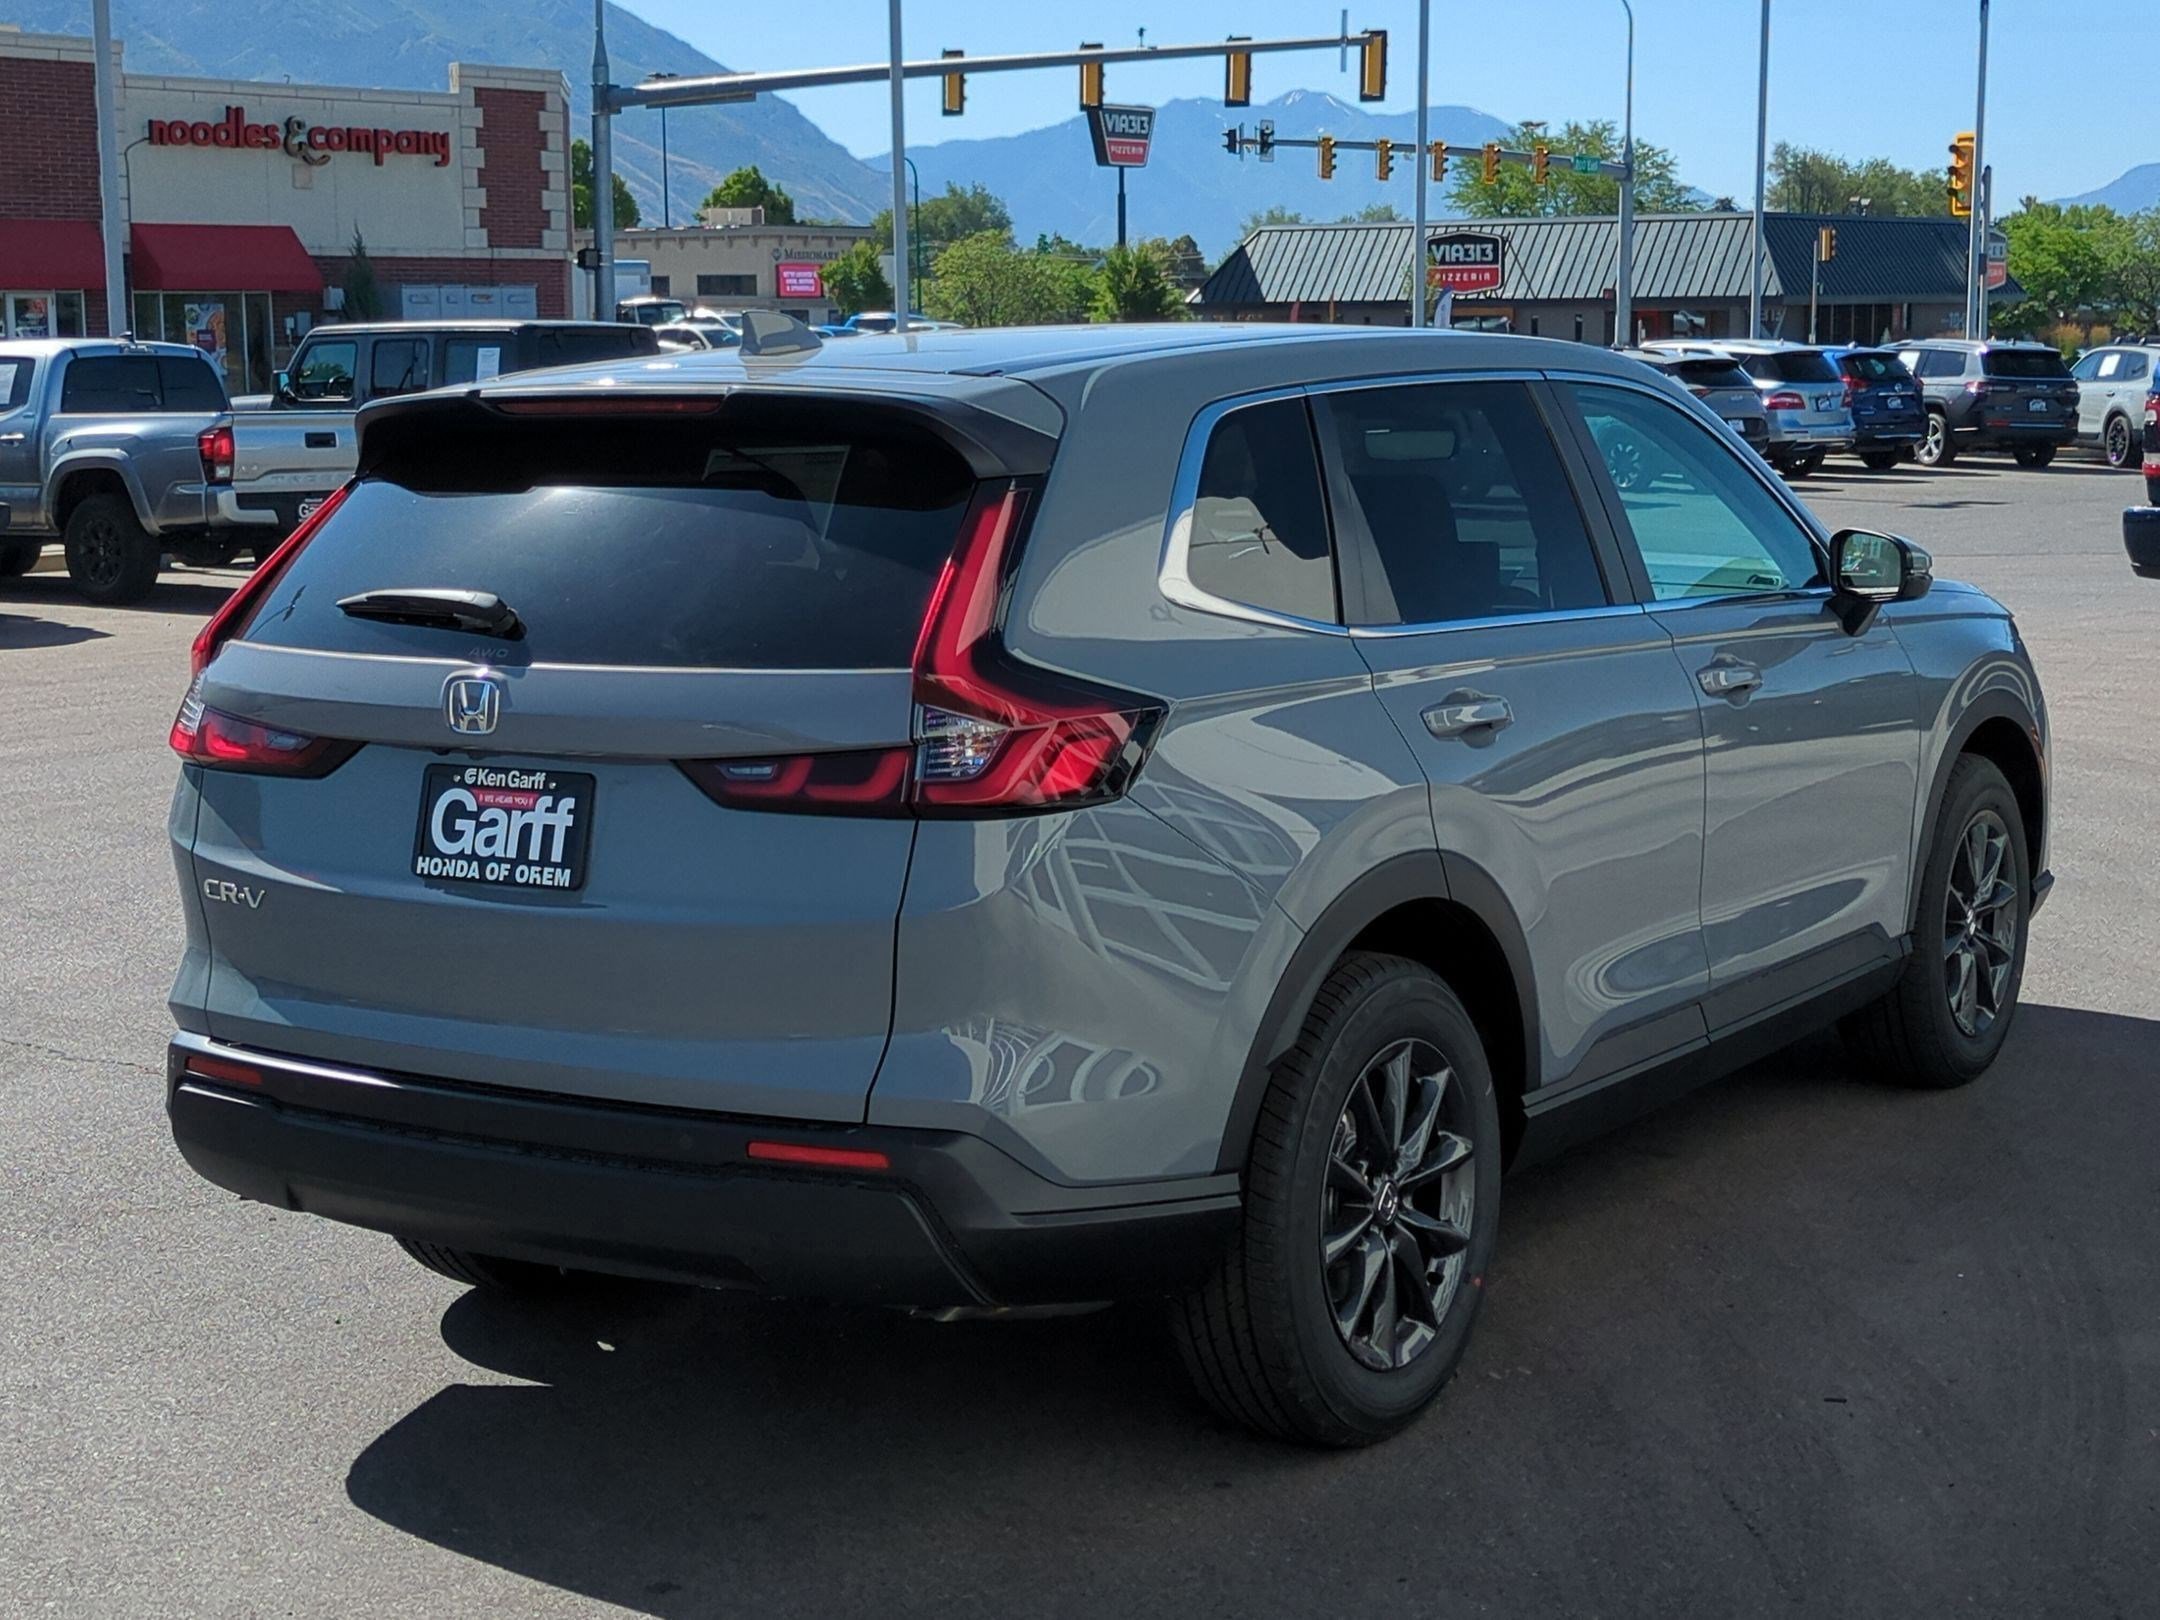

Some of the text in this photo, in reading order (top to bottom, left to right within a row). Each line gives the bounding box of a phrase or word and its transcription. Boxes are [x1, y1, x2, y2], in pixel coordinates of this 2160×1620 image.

[148, 105, 450, 167] noodles & company
[468, 647, 509, 658] AWD
[477, 768, 506, 787] Ken
[507, 770, 547, 790] Garff
[431, 788, 576, 863] Garff
[416, 856, 571, 887] HONDA OF OREM
